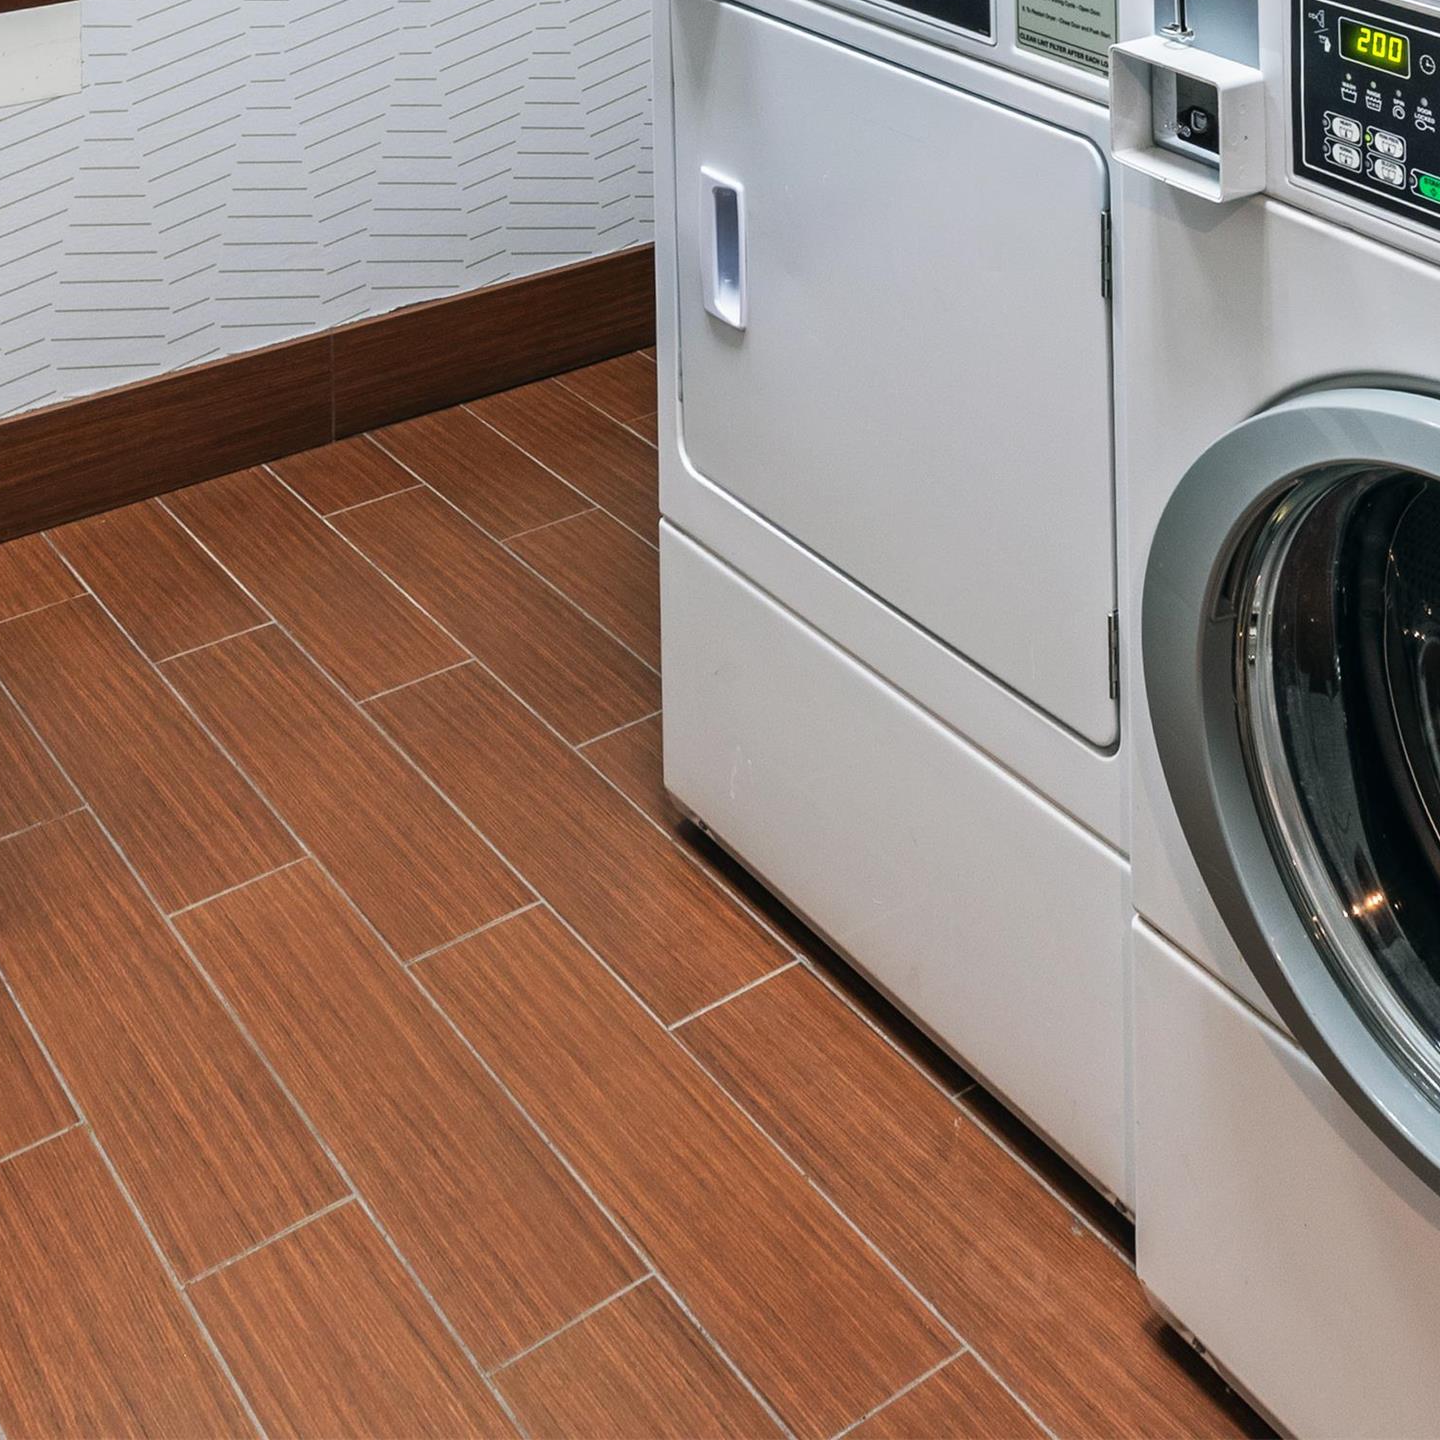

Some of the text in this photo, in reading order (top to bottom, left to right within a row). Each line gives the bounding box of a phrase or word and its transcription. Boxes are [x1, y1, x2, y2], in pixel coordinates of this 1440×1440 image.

[1067, 48, 1084, 61] AFTER
[1085, 54, 1100, 65] EACH
[1357, 27, 1402, 63] 200
